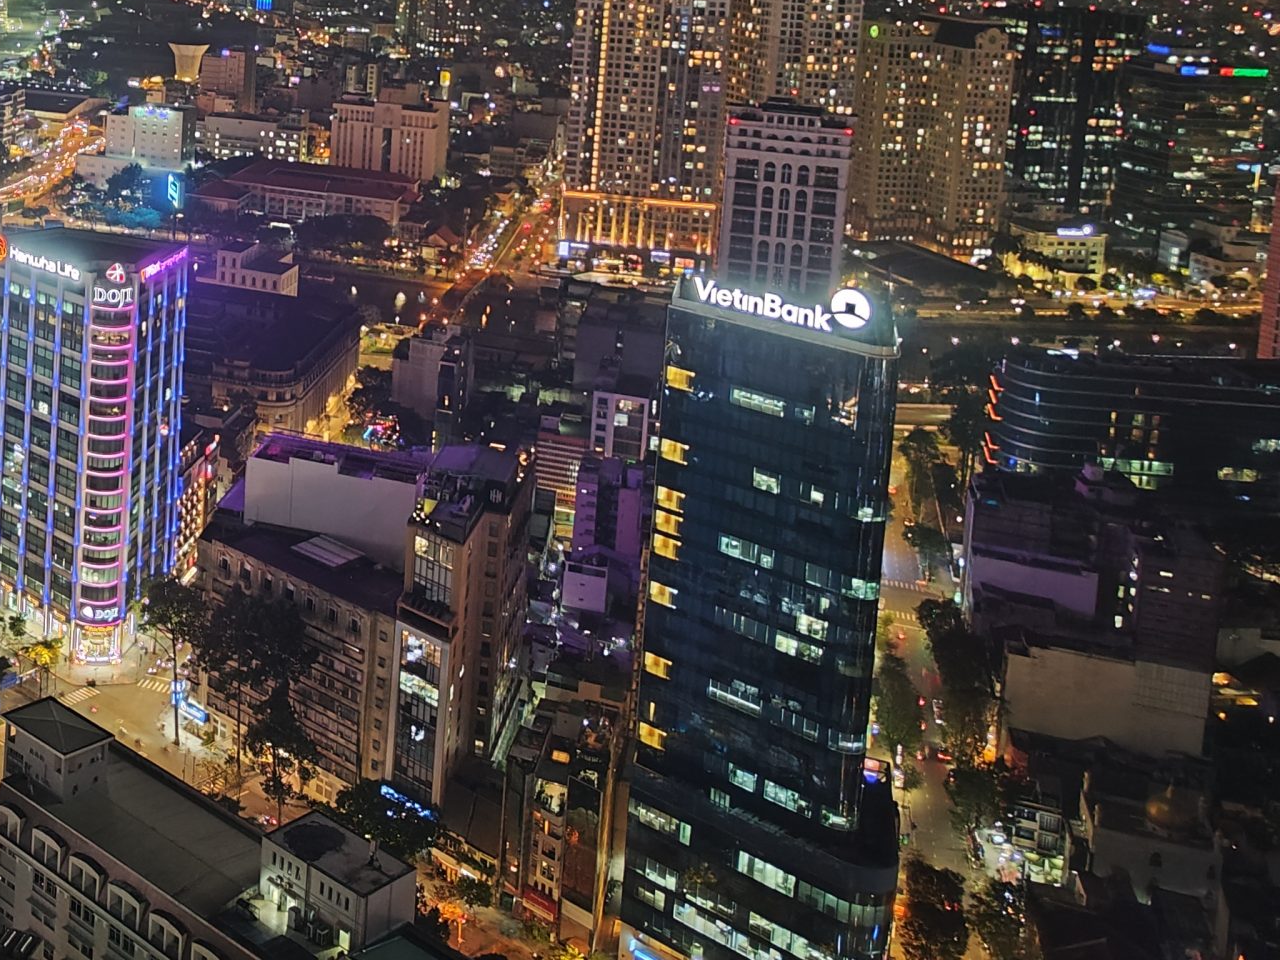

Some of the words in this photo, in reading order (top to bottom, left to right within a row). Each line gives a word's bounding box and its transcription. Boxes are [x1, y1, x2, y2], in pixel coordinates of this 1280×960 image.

[9, 245, 56, 273] Hanwha
[56, 260, 80, 281] Life
[93, 286, 133, 309] DOJI
[693, 276, 833, 332] VietinBank
[94, 607, 119, 622] DOJI
